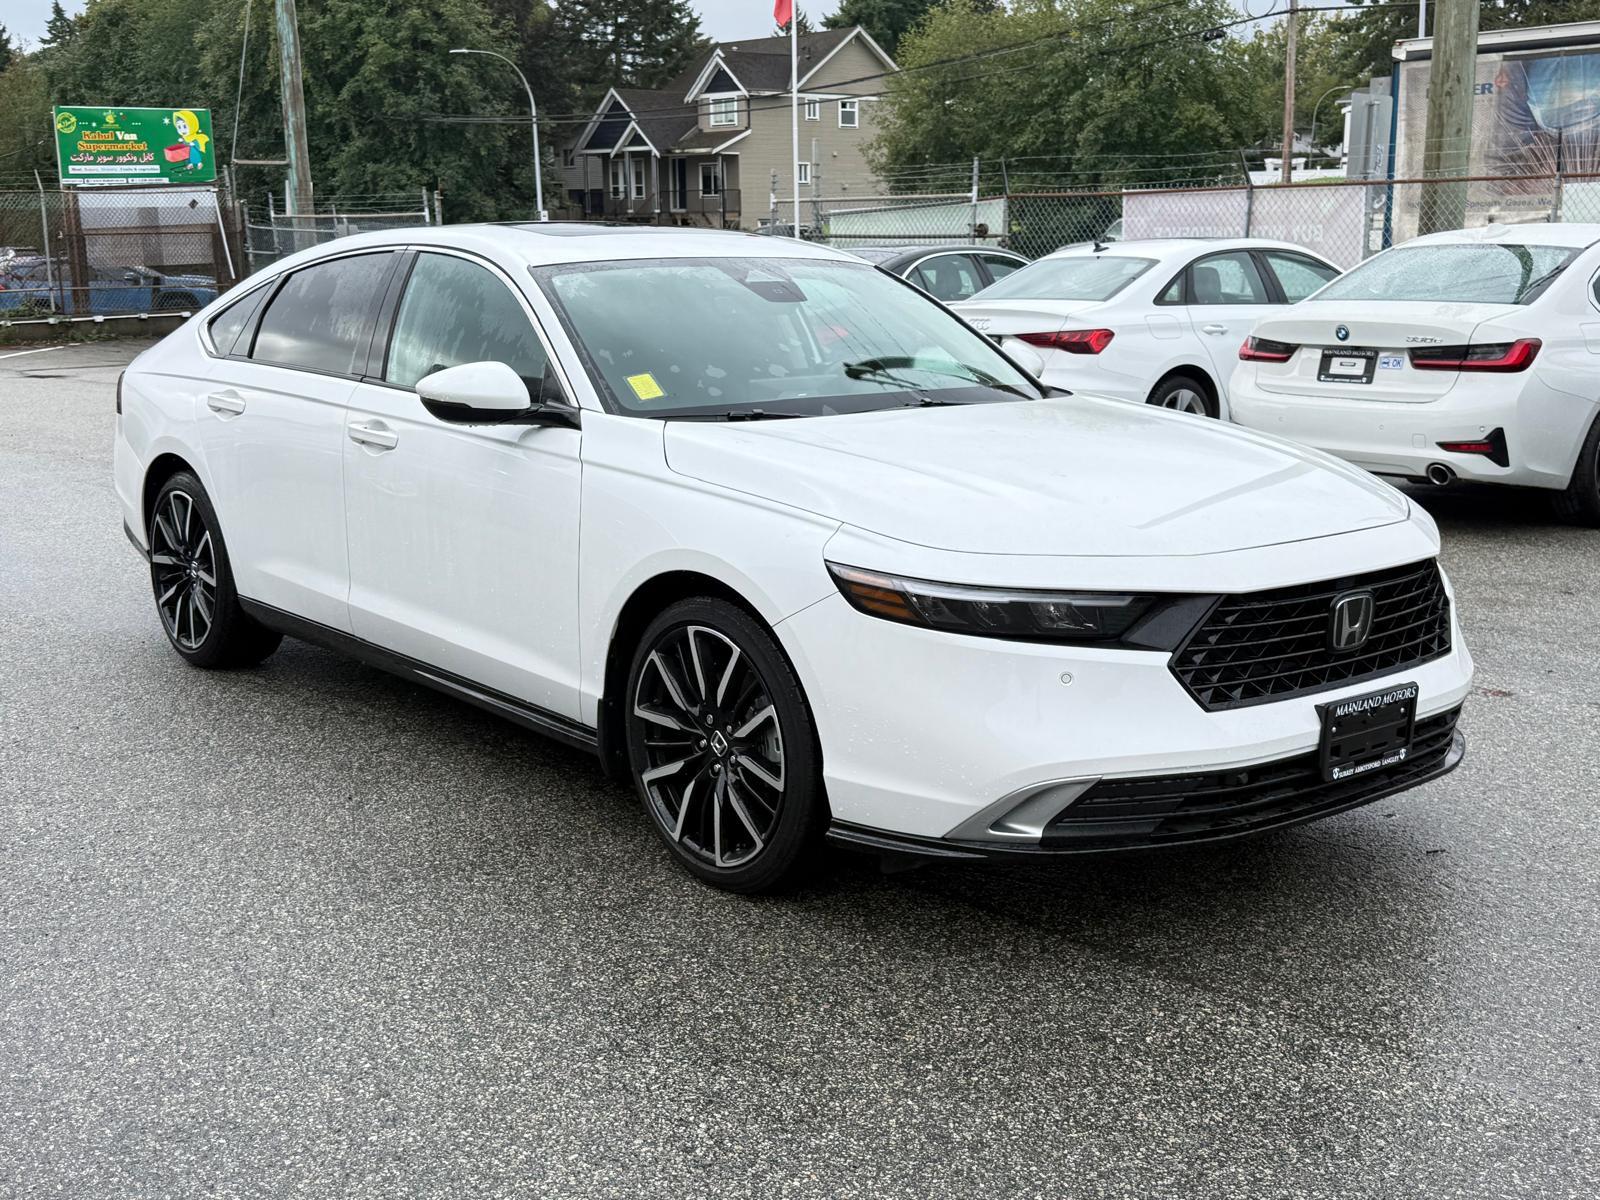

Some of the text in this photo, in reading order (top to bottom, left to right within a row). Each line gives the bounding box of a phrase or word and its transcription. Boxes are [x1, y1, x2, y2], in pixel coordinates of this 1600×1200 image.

[82, 131, 138, 140] Kabul Van
[77, 141, 147, 153] Supermarket
[1392, 360, 1402, 368] OK
[1336, 687, 1417, 717] MAINLAND MOTORS
[1339, 755, 1400, 779] SURREY ABBOTSFORD LANGLEY
